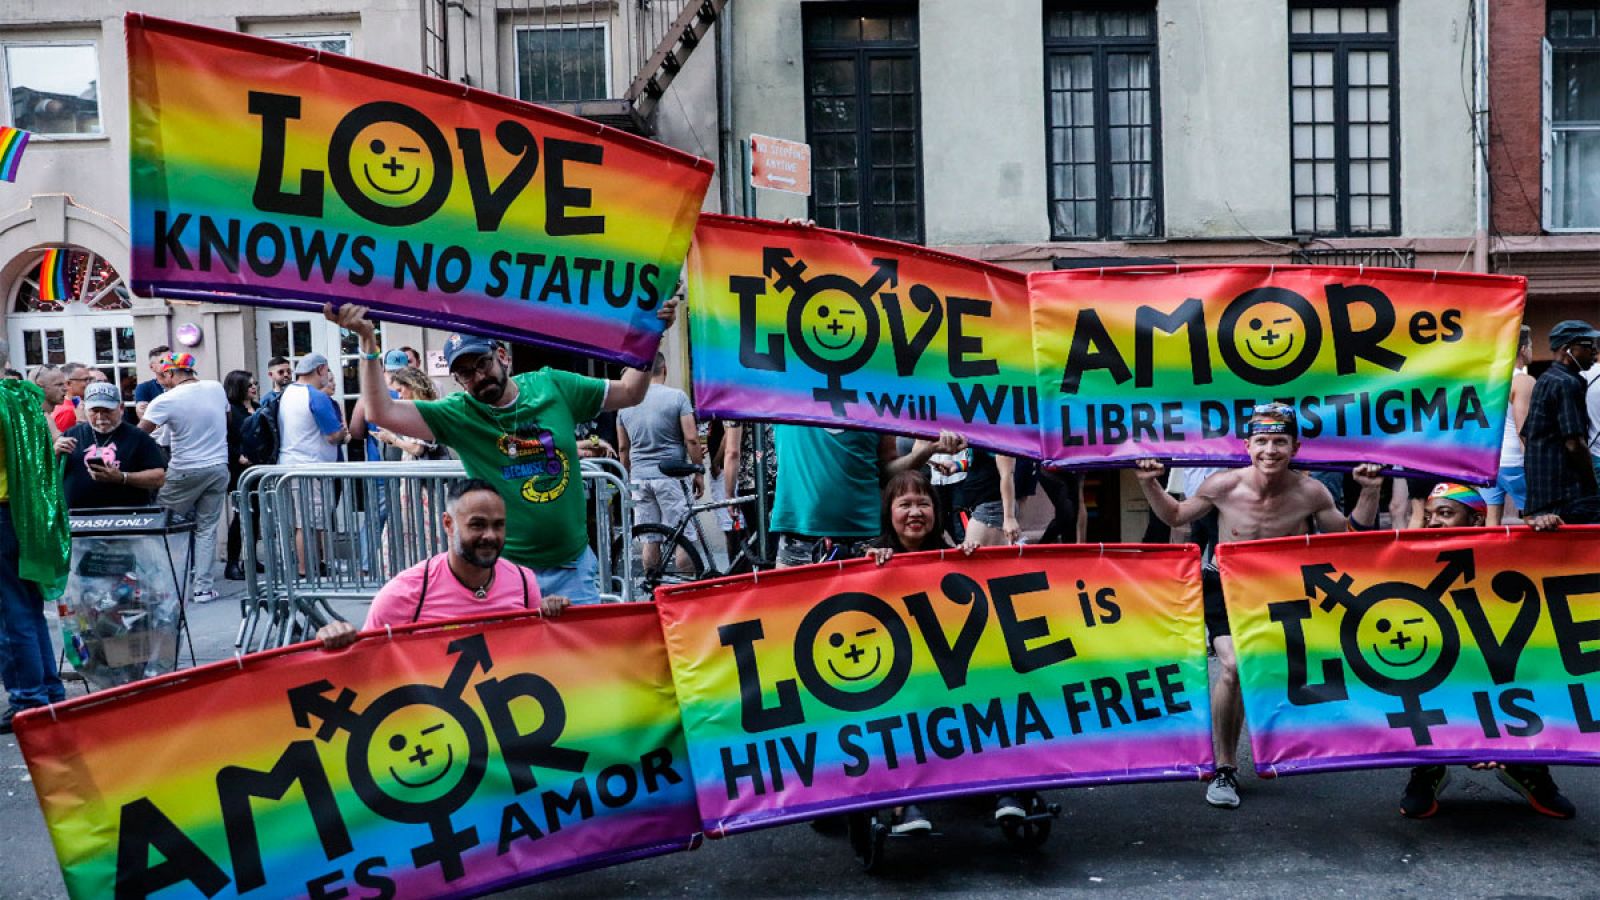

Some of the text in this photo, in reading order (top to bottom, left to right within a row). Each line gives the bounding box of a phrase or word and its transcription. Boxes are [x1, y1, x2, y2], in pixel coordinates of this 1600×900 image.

[248, 91, 605, 236] LOVE
[154, 211, 660, 311] KNOWS NO STATUS
[730, 274, 999, 377] LOVE
[1060, 283, 1463, 393] AMOR es
[865, 392, 937, 421] Will
[1061, 387, 1489, 447] LIBRE DE STIGMA
[115, 518, 154, 526] ONLY
[718, 571, 1121, 732] LOVE is
[1268, 570, 1600, 705] LOVE
[720, 663, 1192, 801] HIV STIGMA FREE
[1472, 688, 1544, 738] IS
[114, 672, 588, 900] AMOR
[307, 747, 682, 900] ES AMOR
